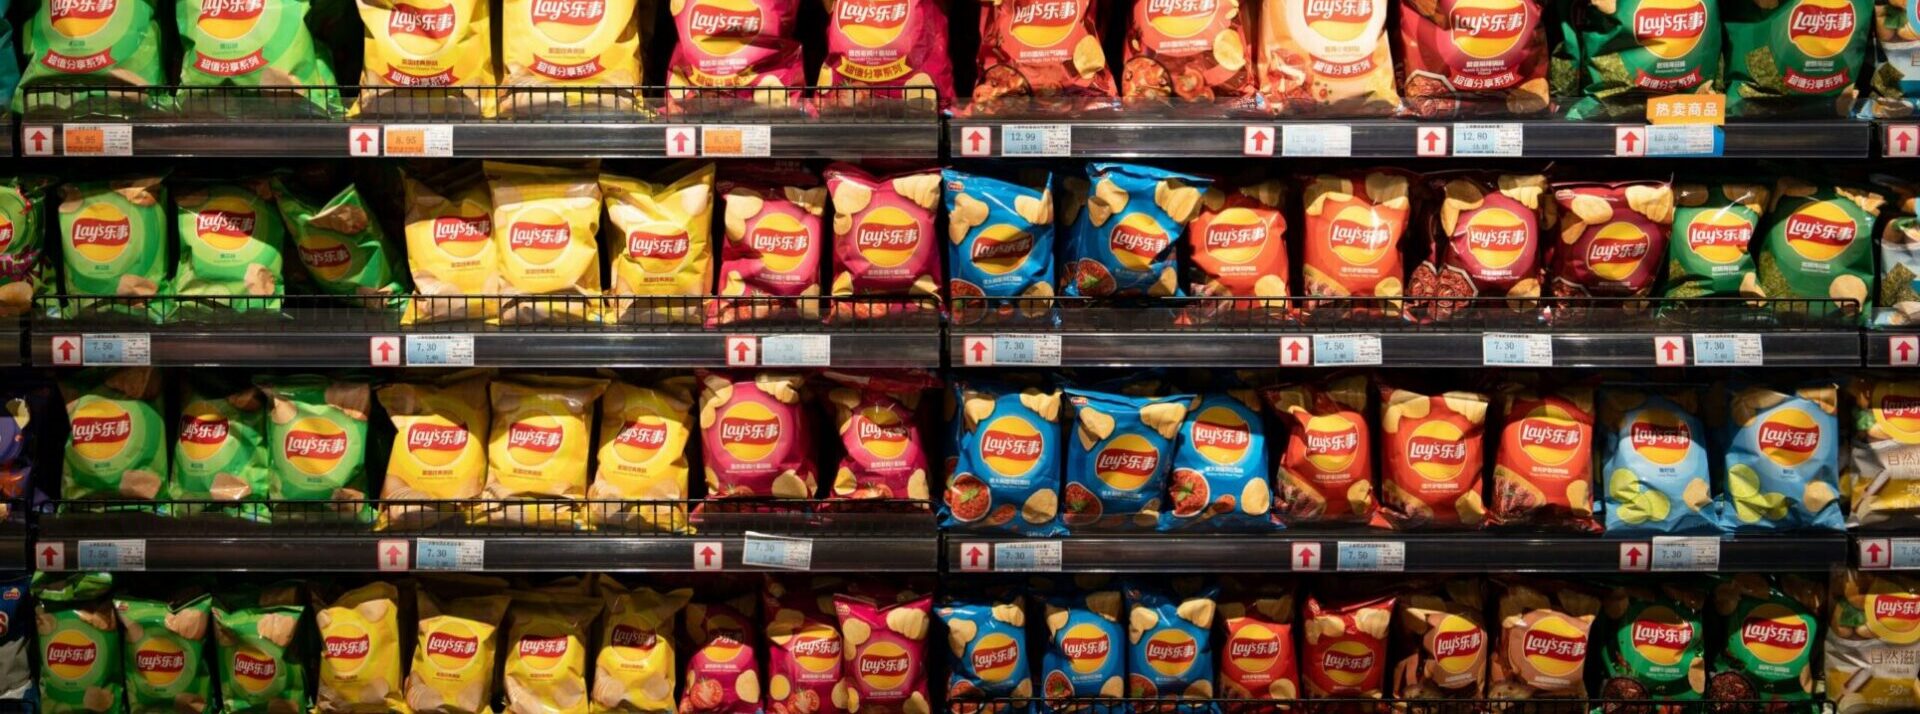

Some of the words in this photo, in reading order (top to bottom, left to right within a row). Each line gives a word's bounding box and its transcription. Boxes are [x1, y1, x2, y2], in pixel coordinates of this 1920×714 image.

[47, 51, 107, 70] 超值分享系列
[200, 53, 260, 73] 超值分享系列
[536, 61, 596, 78] 超值分享系列
[844, 63, 904, 78] 超值分享系列
[1313, 60, 1371, 76] 超值分享系列
[1453, 72, 1515, 89] 超值分享系列
[1640, 73, 1697, 90] 超值分享系列
[1787, 73, 1844, 90] 超值分享系列
[1655, 101, 1718, 117] 热卖商品
[1010, 132, 1036, 142] 12.99
[1462, 131, 1488, 141] 12.80
[416, 343, 437, 352] 7.30
[1004, 341, 1025, 351] 7.30
[1324, 341, 1345, 351] 7.50
[1494, 341, 1515, 350] 7.30
[1704, 341, 1725, 351] 7.30
[754, 542, 775, 553] 7.30
[427, 549, 447, 559] 7.30
[1005, 551, 1026, 561] 7.30
[1348, 551, 1368, 561] 7.50
[1662, 550, 1683, 560] 7.30
[1871, 648, 1920, 665] 自然滋
